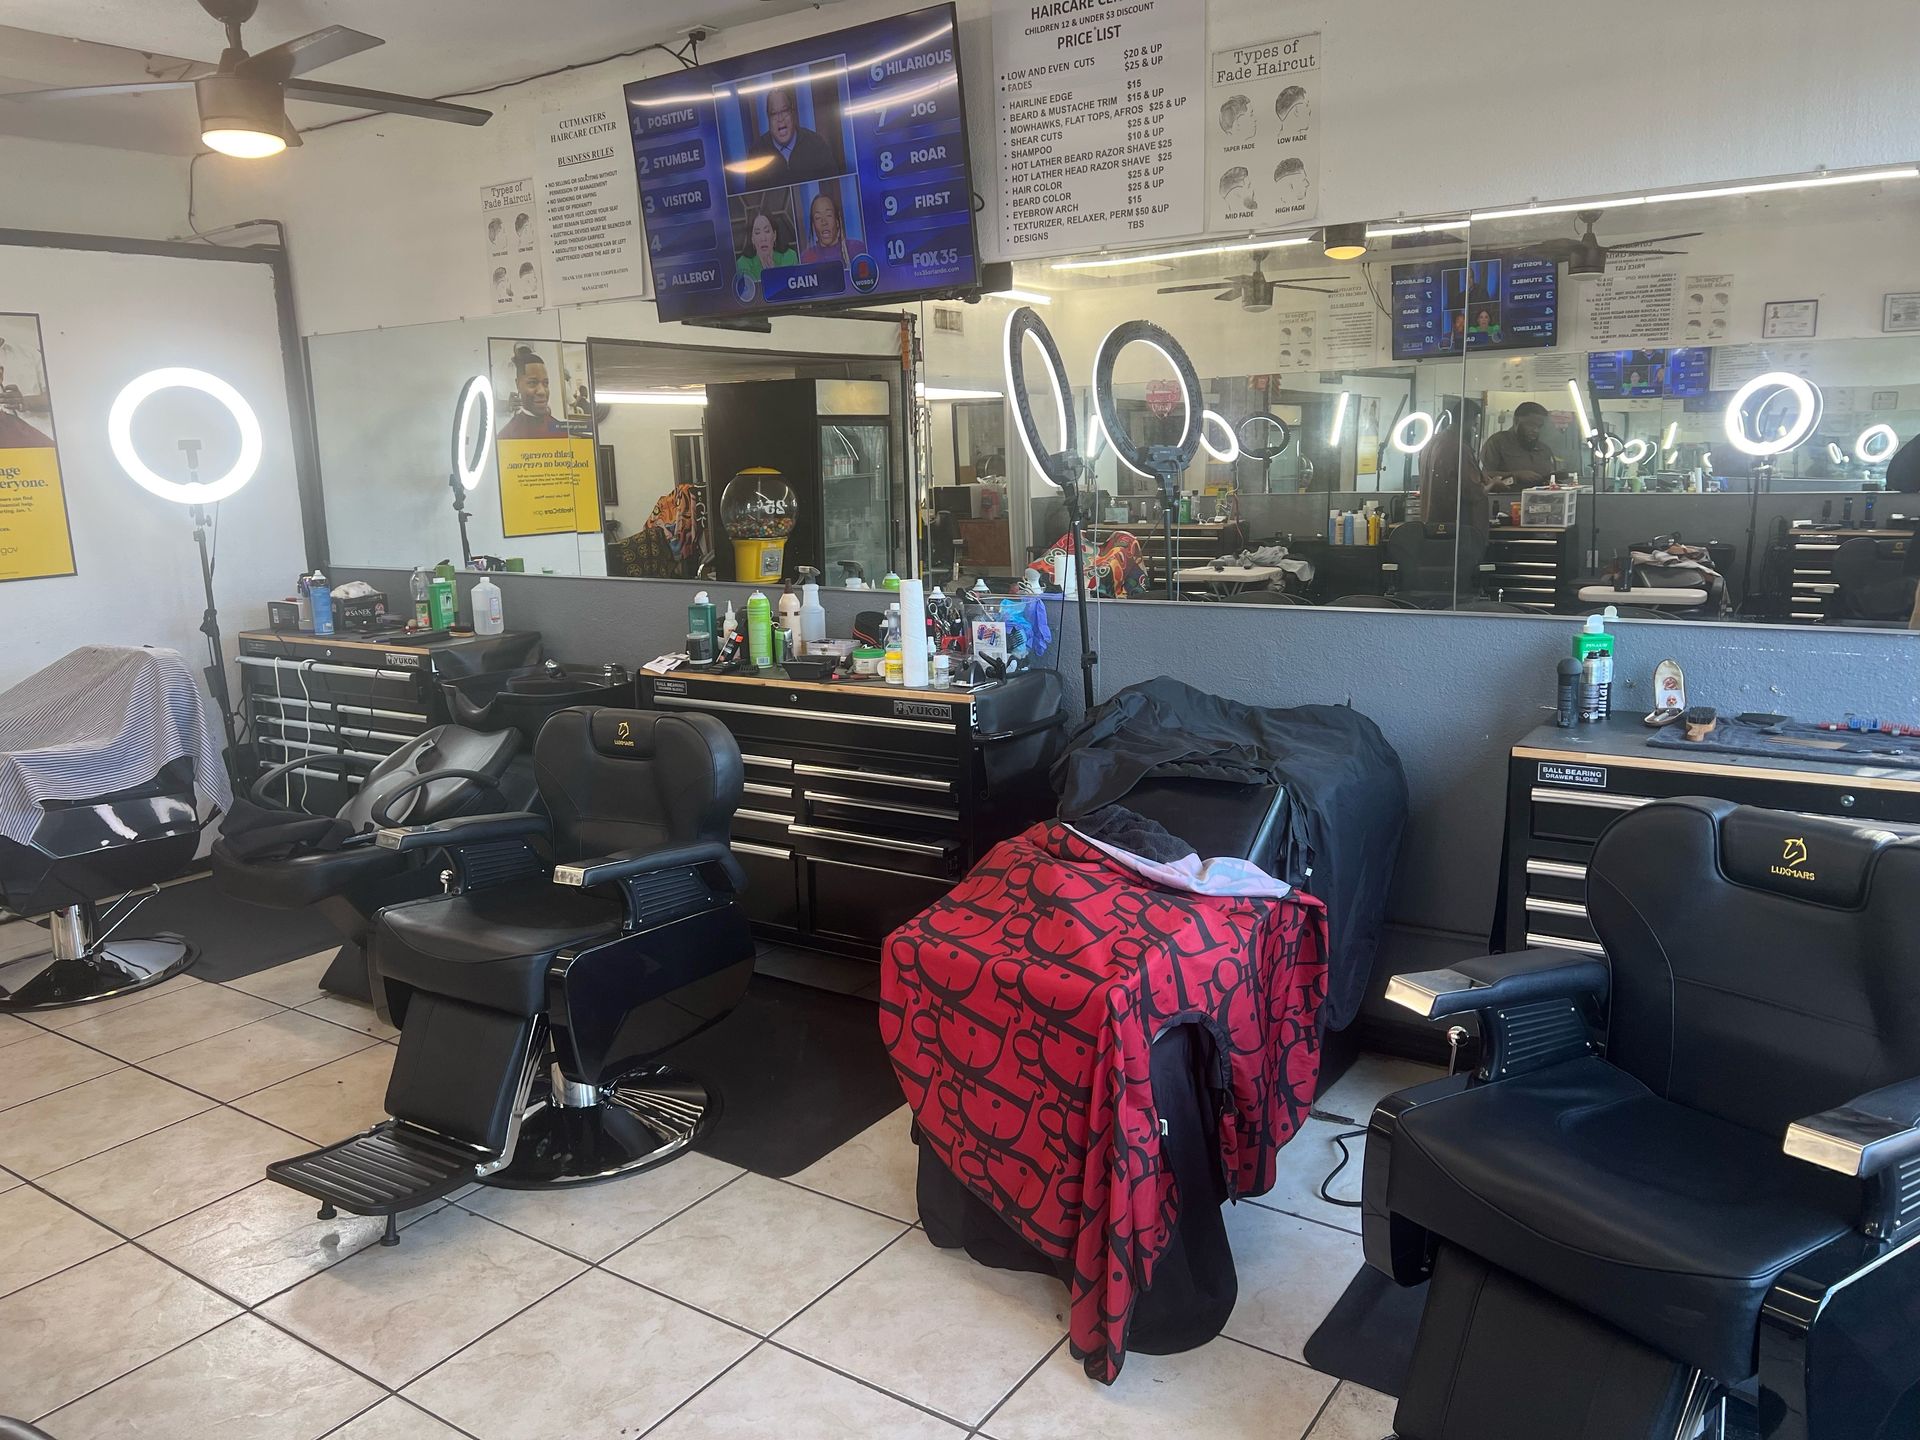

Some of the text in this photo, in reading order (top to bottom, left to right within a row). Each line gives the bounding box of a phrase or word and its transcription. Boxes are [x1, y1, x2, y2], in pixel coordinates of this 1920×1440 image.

[1024, 22, 1060, 36] CHILDREN
[1072, 19, 1078, 27] &
[1080, 13, 1104, 25] UNDER
[1106, 10, 1115, 20] $3
[1116, 2, 1154, 17] DISCOUNT
[1031, 0, 1094, 20] HAIRCARE
[1058, 24, 1122, 50] PRICE LIST
[1007, 44, 1162, 81] LOW AND EVEN CUTS $20 & UP
[1234, 40, 1300, 65] Types of
[870, 50, 952, 82] 6 HILARIOUS
[1008, 56, 1163, 92] FADES $25 & UP
[1216, 54, 1316, 84] Fade Haircut
[1010, 80, 1142, 110] HAIRLINE EDGE $15
[1010, 88, 1164, 122] BEARD & MUSTACHE TRIM $15 & UP
[560, 112, 606, 129] CUTMASTERS
[634, 109, 694, 134] 1 POSITIVE
[876, 101, 936, 128] 7 JOG
[1010, 96, 1186, 134] MOWHAWKS, FLAT TOPS, AFROS $25 & UP
[550, 122, 616, 142] HAIRCARE CENTER
[1010, 114, 1164, 146] SHEAR CUTS $25 & UP
[1011, 127, 1164, 159] SHAMPOO $10 & UP
[1012, 139, 1172, 171] HOT LATHER BEARD RAZOR SHAVE $25
[558, 147, 614, 166] BUSINESS RULES
[640, 150, 700, 174] 2 STUMBLE
[880, 146, 946, 172] 8 ROAR
[1012, 152, 1172, 183] HOT LATHER HEAD RAZOR SHAVE $25
[491, 182, 522, 198] Types of
[1012, 166, 1164, 195] HAIR COLOR $25 & UP
[1012, 178, 1164, 208] BEARD COLOR $25 & UP
[484, 194, 532, 209] Fade Haircut
[644, 191, 702, 213] 3 VISITOR
[884, 191, 950, 216] 9 FIRST
[1013, 195, 1142, 220] EYEBROW ARCH $15
[1290, 204, 1306, 212] FADE
[1014, 218, 1064, 231] TEXTURIZER,
[1067, 212, 1108, 224] RELAXER,
[1110, 208, 1134, 220] PERM
[1136, 206, 1149, 216] $50
[651, 234, 662, 251] 4
[1014, 220, 1144, 244] DESIGNS TBS
[888, 240, 904, 260] 10
[656, 270, 716, 290] 5 ALLERGY
[788, 274, 818, 289] GAIN
[394, 656, 418, 665] YUKON
[908, 705, 949, 717] YUKON
[1566, 768, 1602, 778] BEARING
[1771, 866, 1815, 880] LUXMARS
